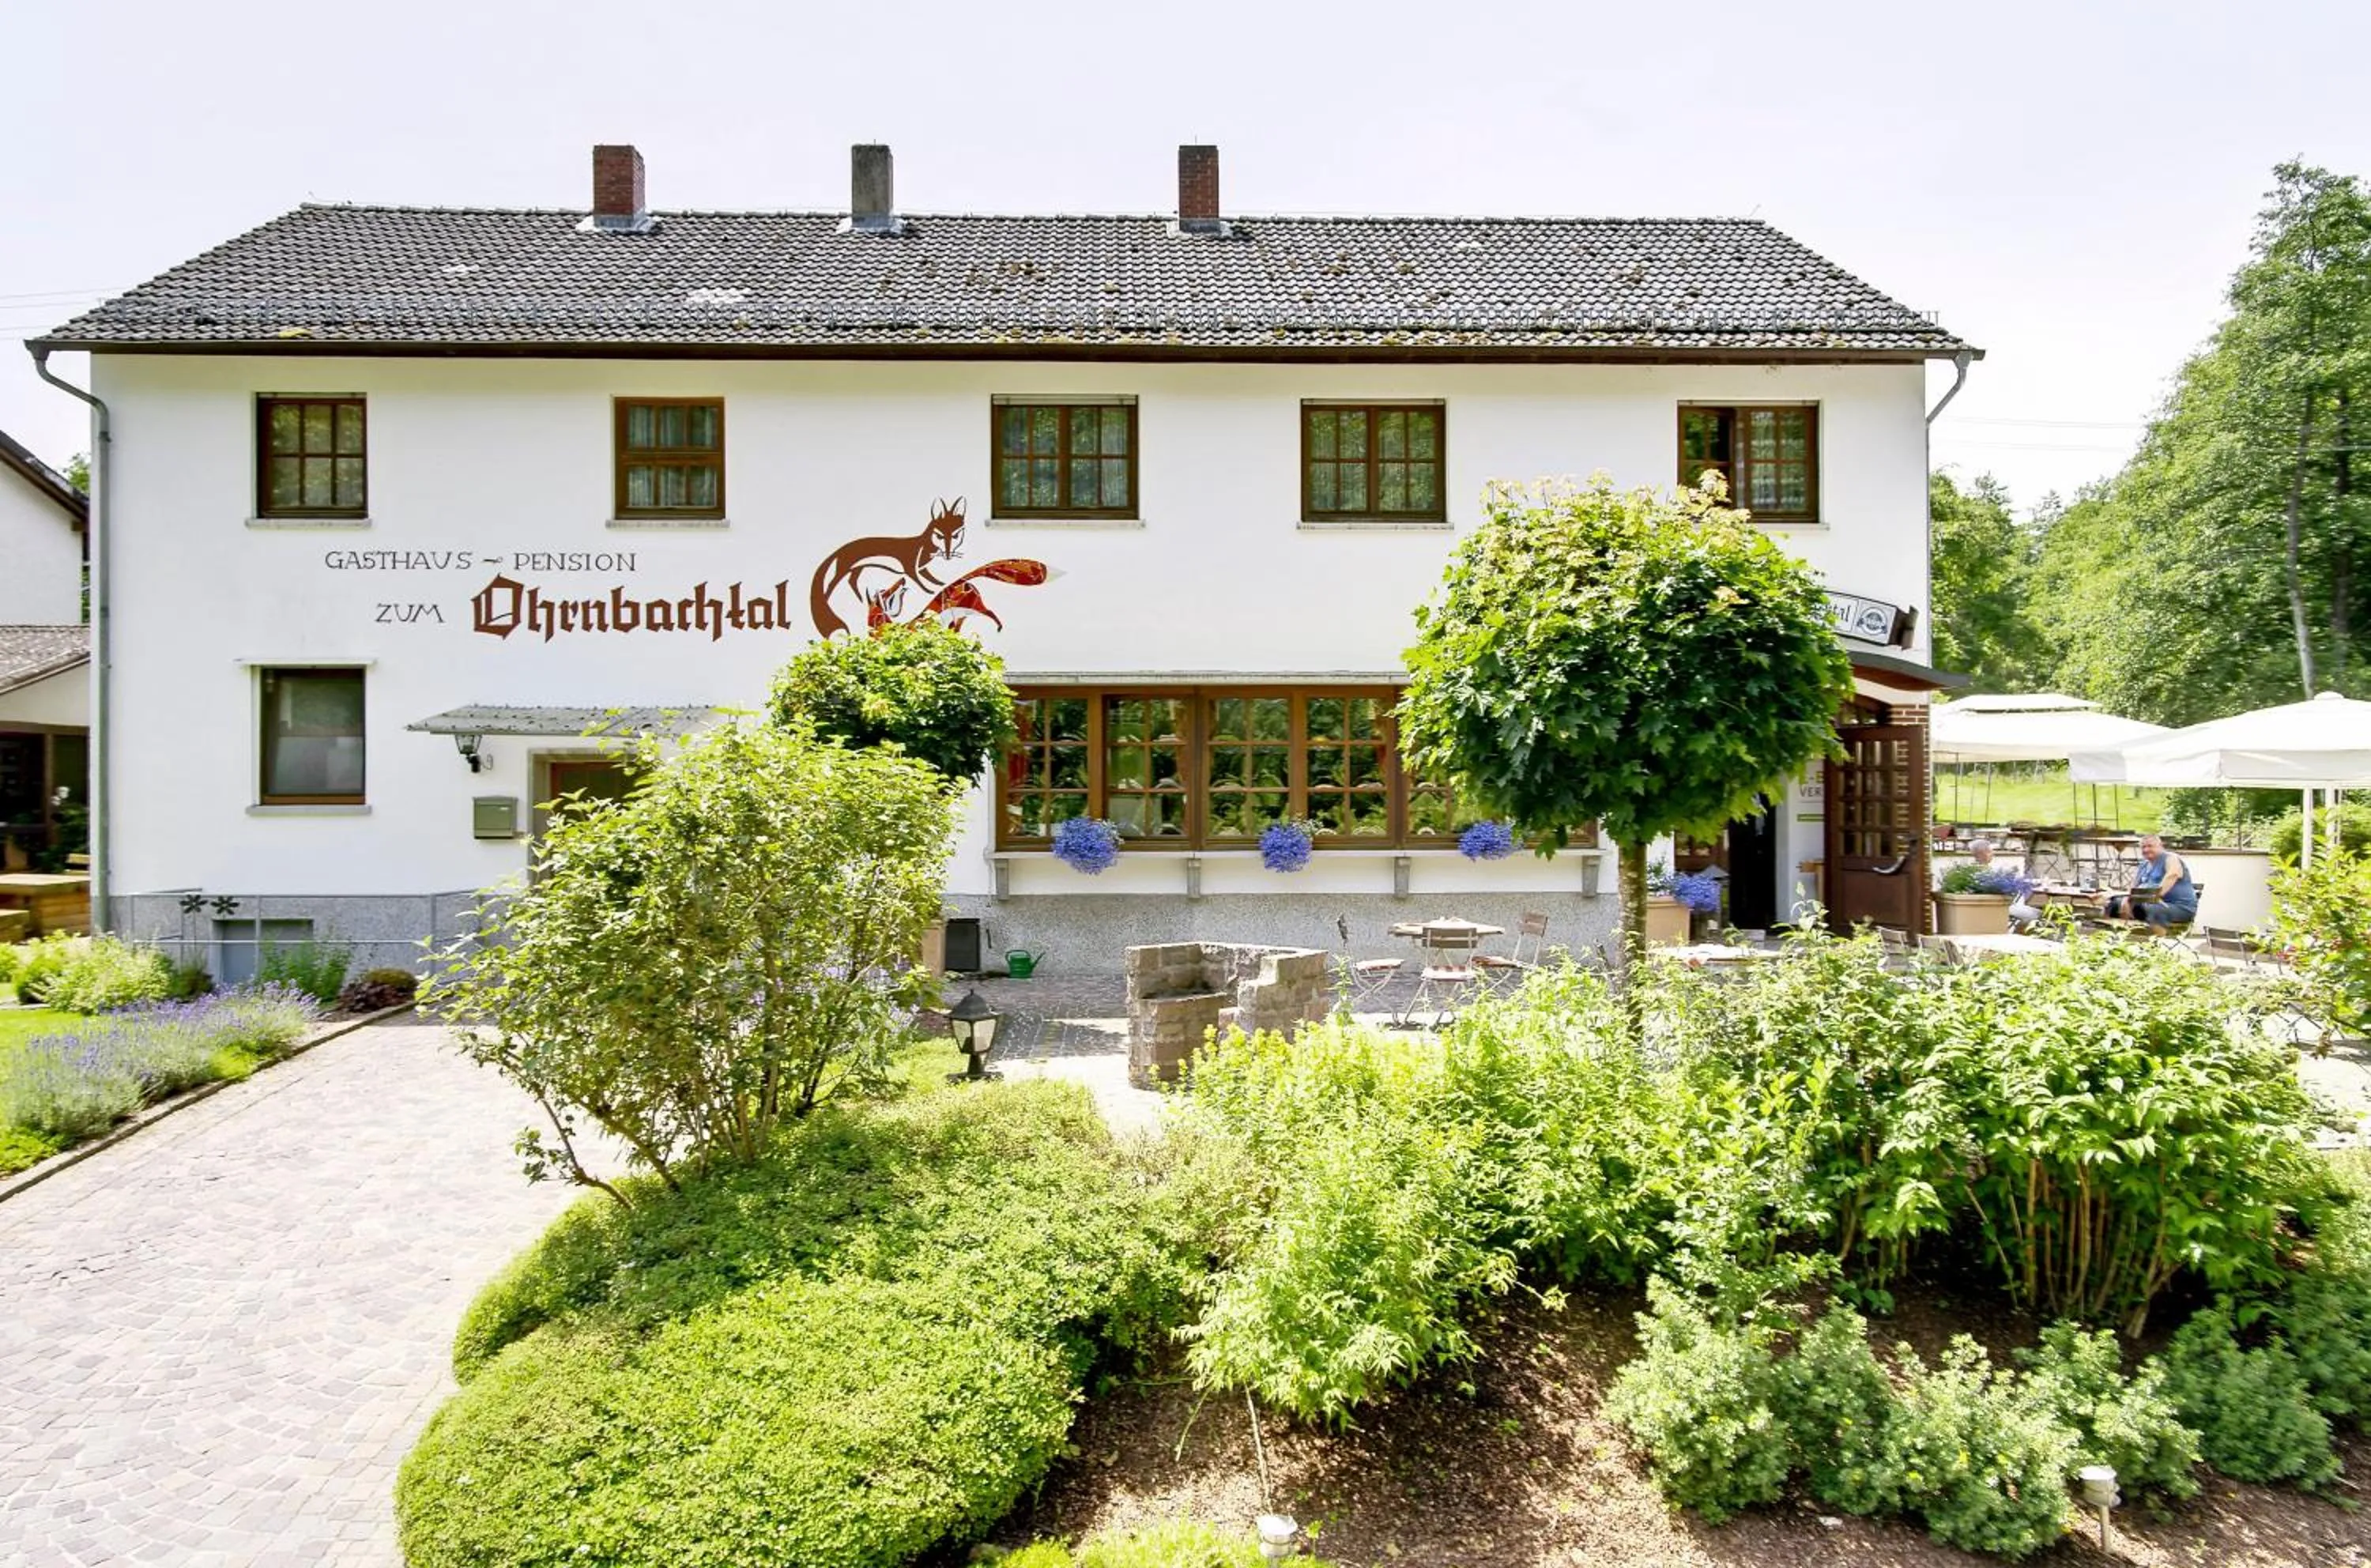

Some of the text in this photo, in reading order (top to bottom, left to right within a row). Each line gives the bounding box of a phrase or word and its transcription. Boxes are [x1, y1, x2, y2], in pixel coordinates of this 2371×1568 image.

[325, 551, 473, 571] GASTHAUS
[514, 552, 635, 571] PENSION
[375, 573, 791, 644] ZUM Ohrnbachtal
